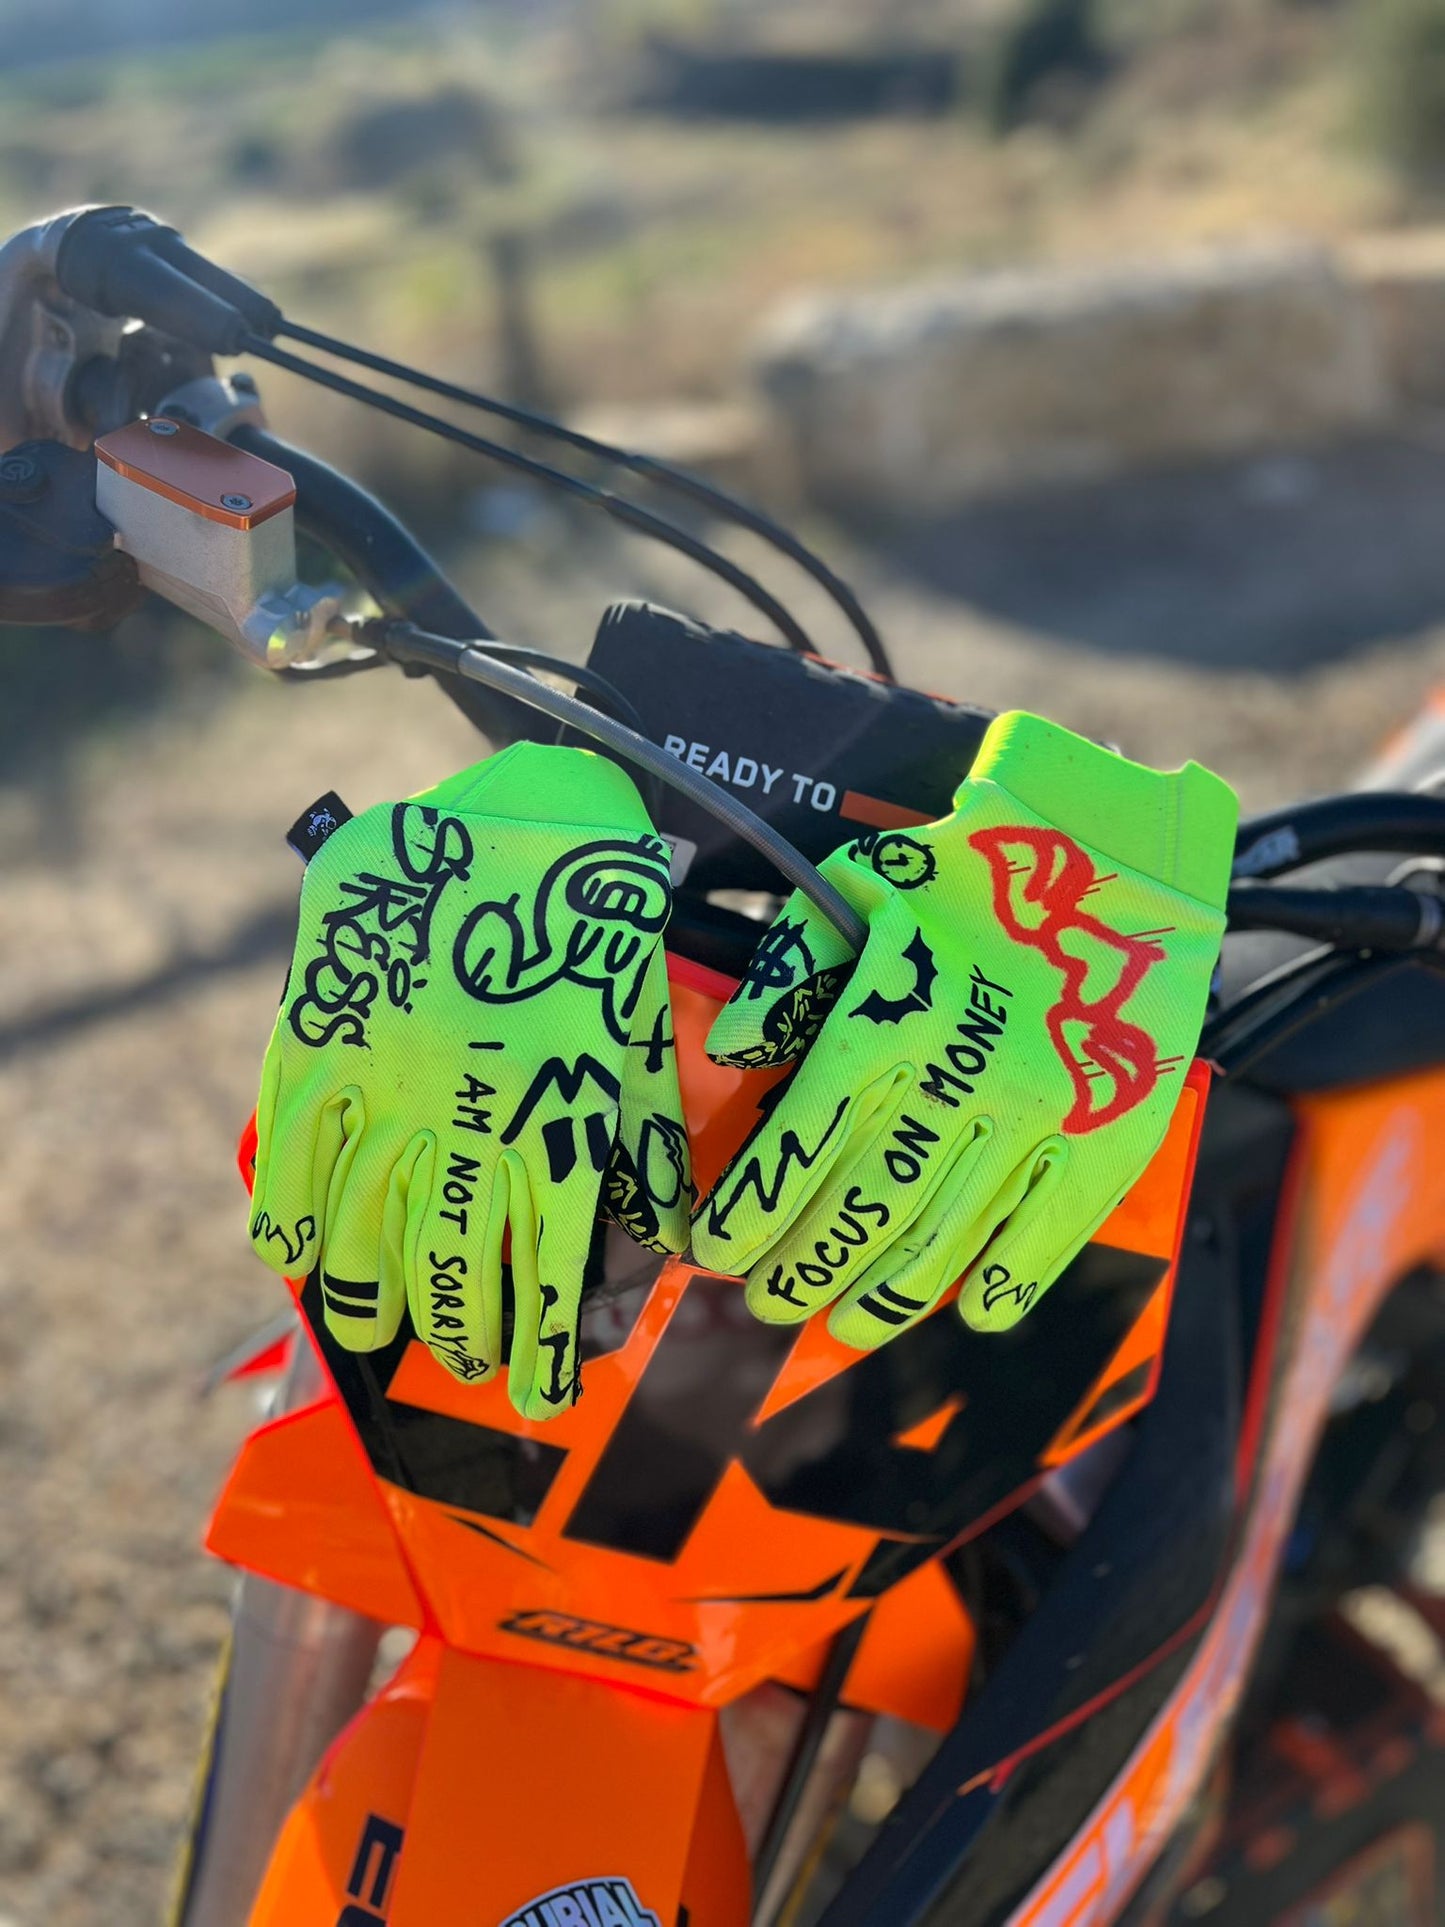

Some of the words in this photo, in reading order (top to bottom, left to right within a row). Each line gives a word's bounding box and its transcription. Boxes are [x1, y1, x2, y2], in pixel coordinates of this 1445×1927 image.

[663, 734, 784, 795] READY
[792, 774, 837, 812] TO
[468, 1041, 504, 1050] I
[453, 1073, 496, 1135] AM
[767, 1186, 890, 1307] FOCUS
[886, 1115, 940, 1184] ON
[920, 964, 1015, 1107] MONEY
[439, 1153, 480, 1234] NOT
[425, 1251, 470, 1357] SORRY
